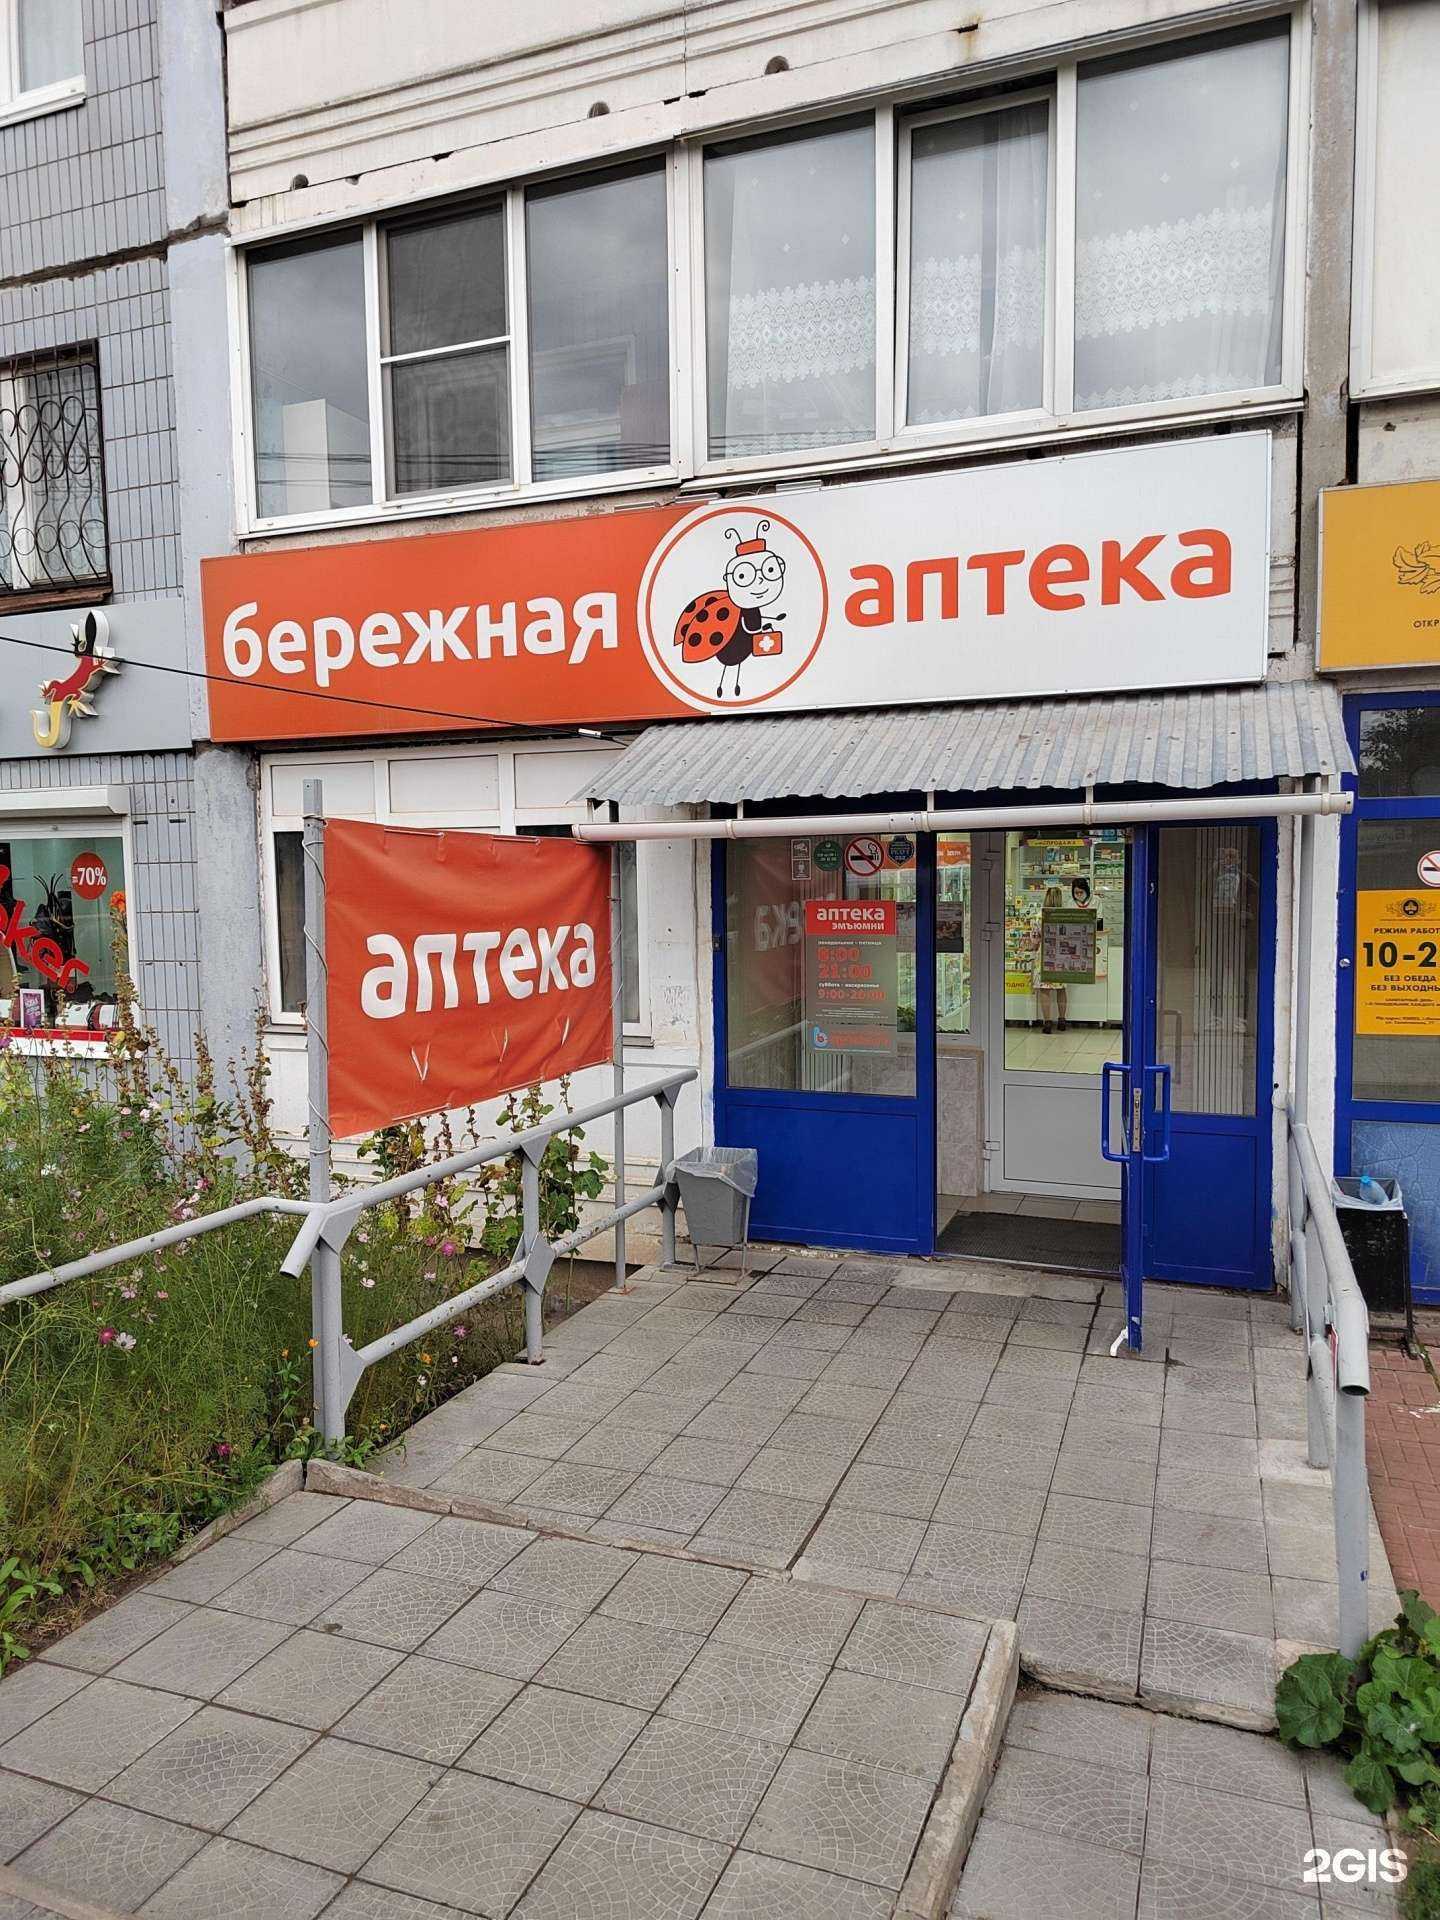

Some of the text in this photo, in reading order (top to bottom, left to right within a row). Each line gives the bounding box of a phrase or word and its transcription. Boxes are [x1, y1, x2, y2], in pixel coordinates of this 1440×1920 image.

[221, 528, 1232, 689] бережная аптека
[1413, 619, 1440, 628] ОТКР
[816, 907, 885, 921] аптека
[1373, 927, 1408, 935] РЕЖИМ
[360, 922, 596, 1020] аптека
[1384, 974, 1437, 983] БЕЗ ОБЕДА
[1370, 984, 1387, 992] БЕЗ
